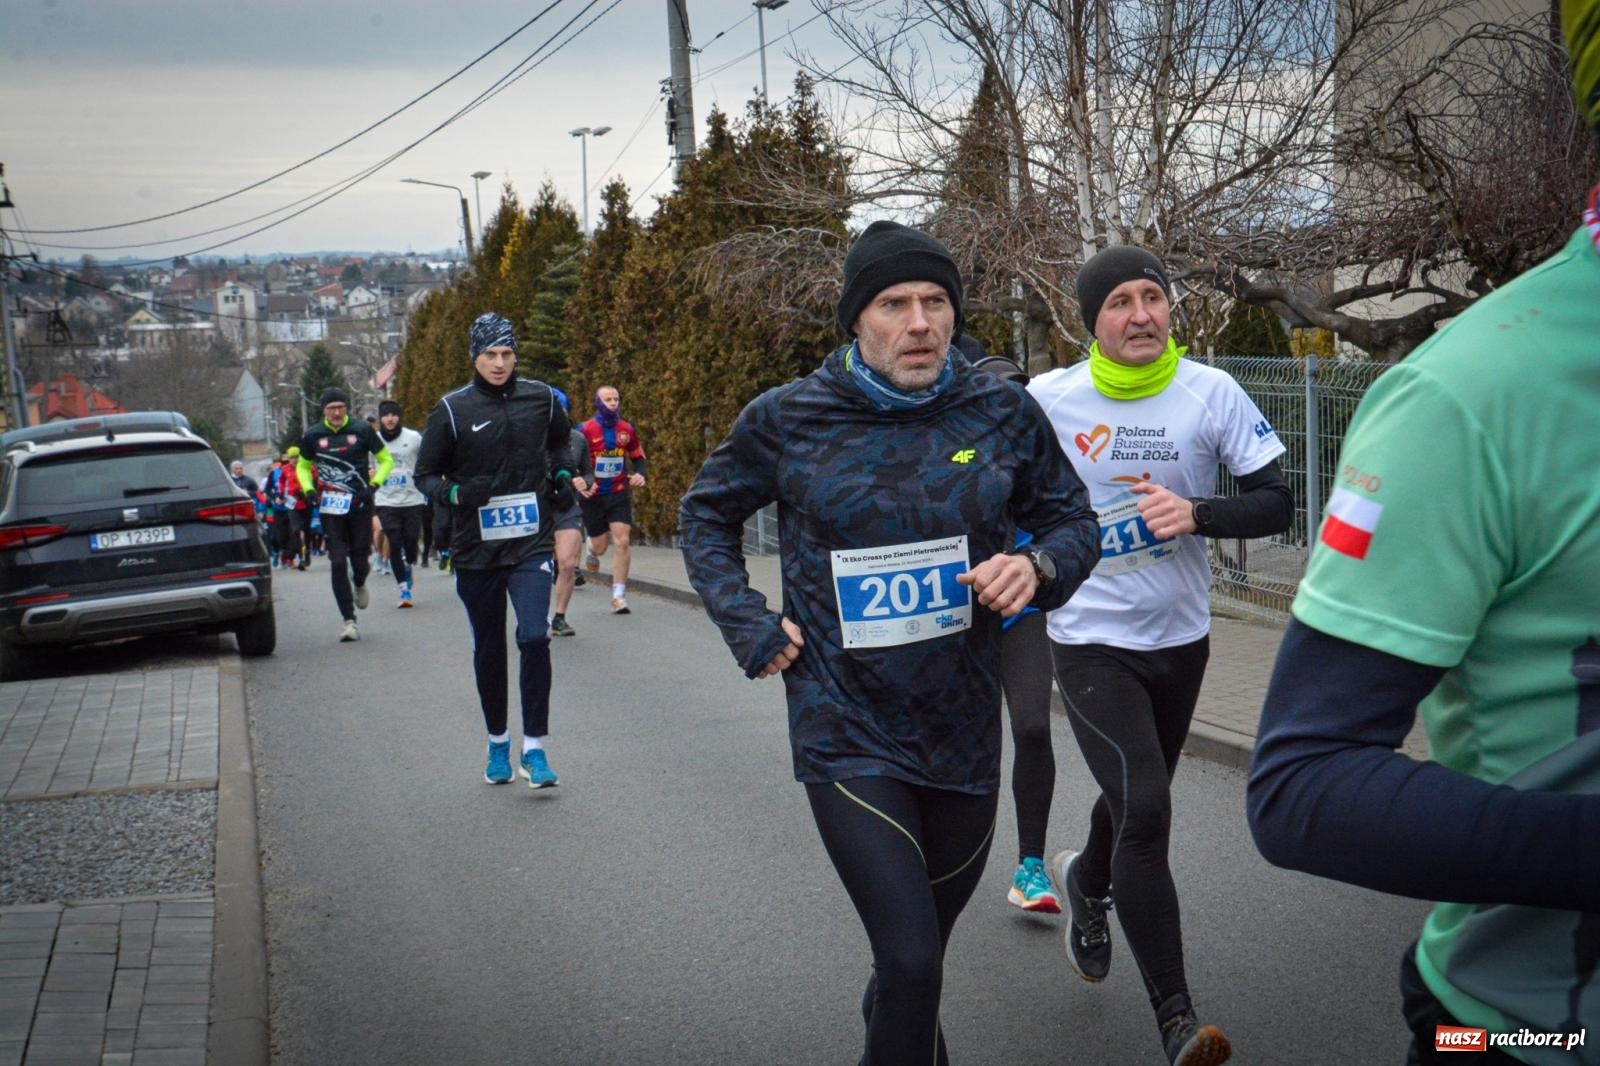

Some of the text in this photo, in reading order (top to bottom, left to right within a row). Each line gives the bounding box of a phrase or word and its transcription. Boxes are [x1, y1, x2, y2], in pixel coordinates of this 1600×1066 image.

[1115, 426, 1166, 437] Poland
[1113, 438, 1174, 450] Business
[952, 449, 975, 463] 4F
[1110, 449, 1179, 461] Run 2024
[326, 497, 345, 508] 120
[490, 504, 530, 527] 131
[100, 527, 170, 548] OP 1239P
[1101, 519, 1148, 553] 41
[863, 554, 883, 562] Cross
[883, 553, 893, 561] po
[893, 549, 914, 558] Ziemi
[914, 543, 959, 556] Pietrowickiej
[860, 567, 950, 617] 201
